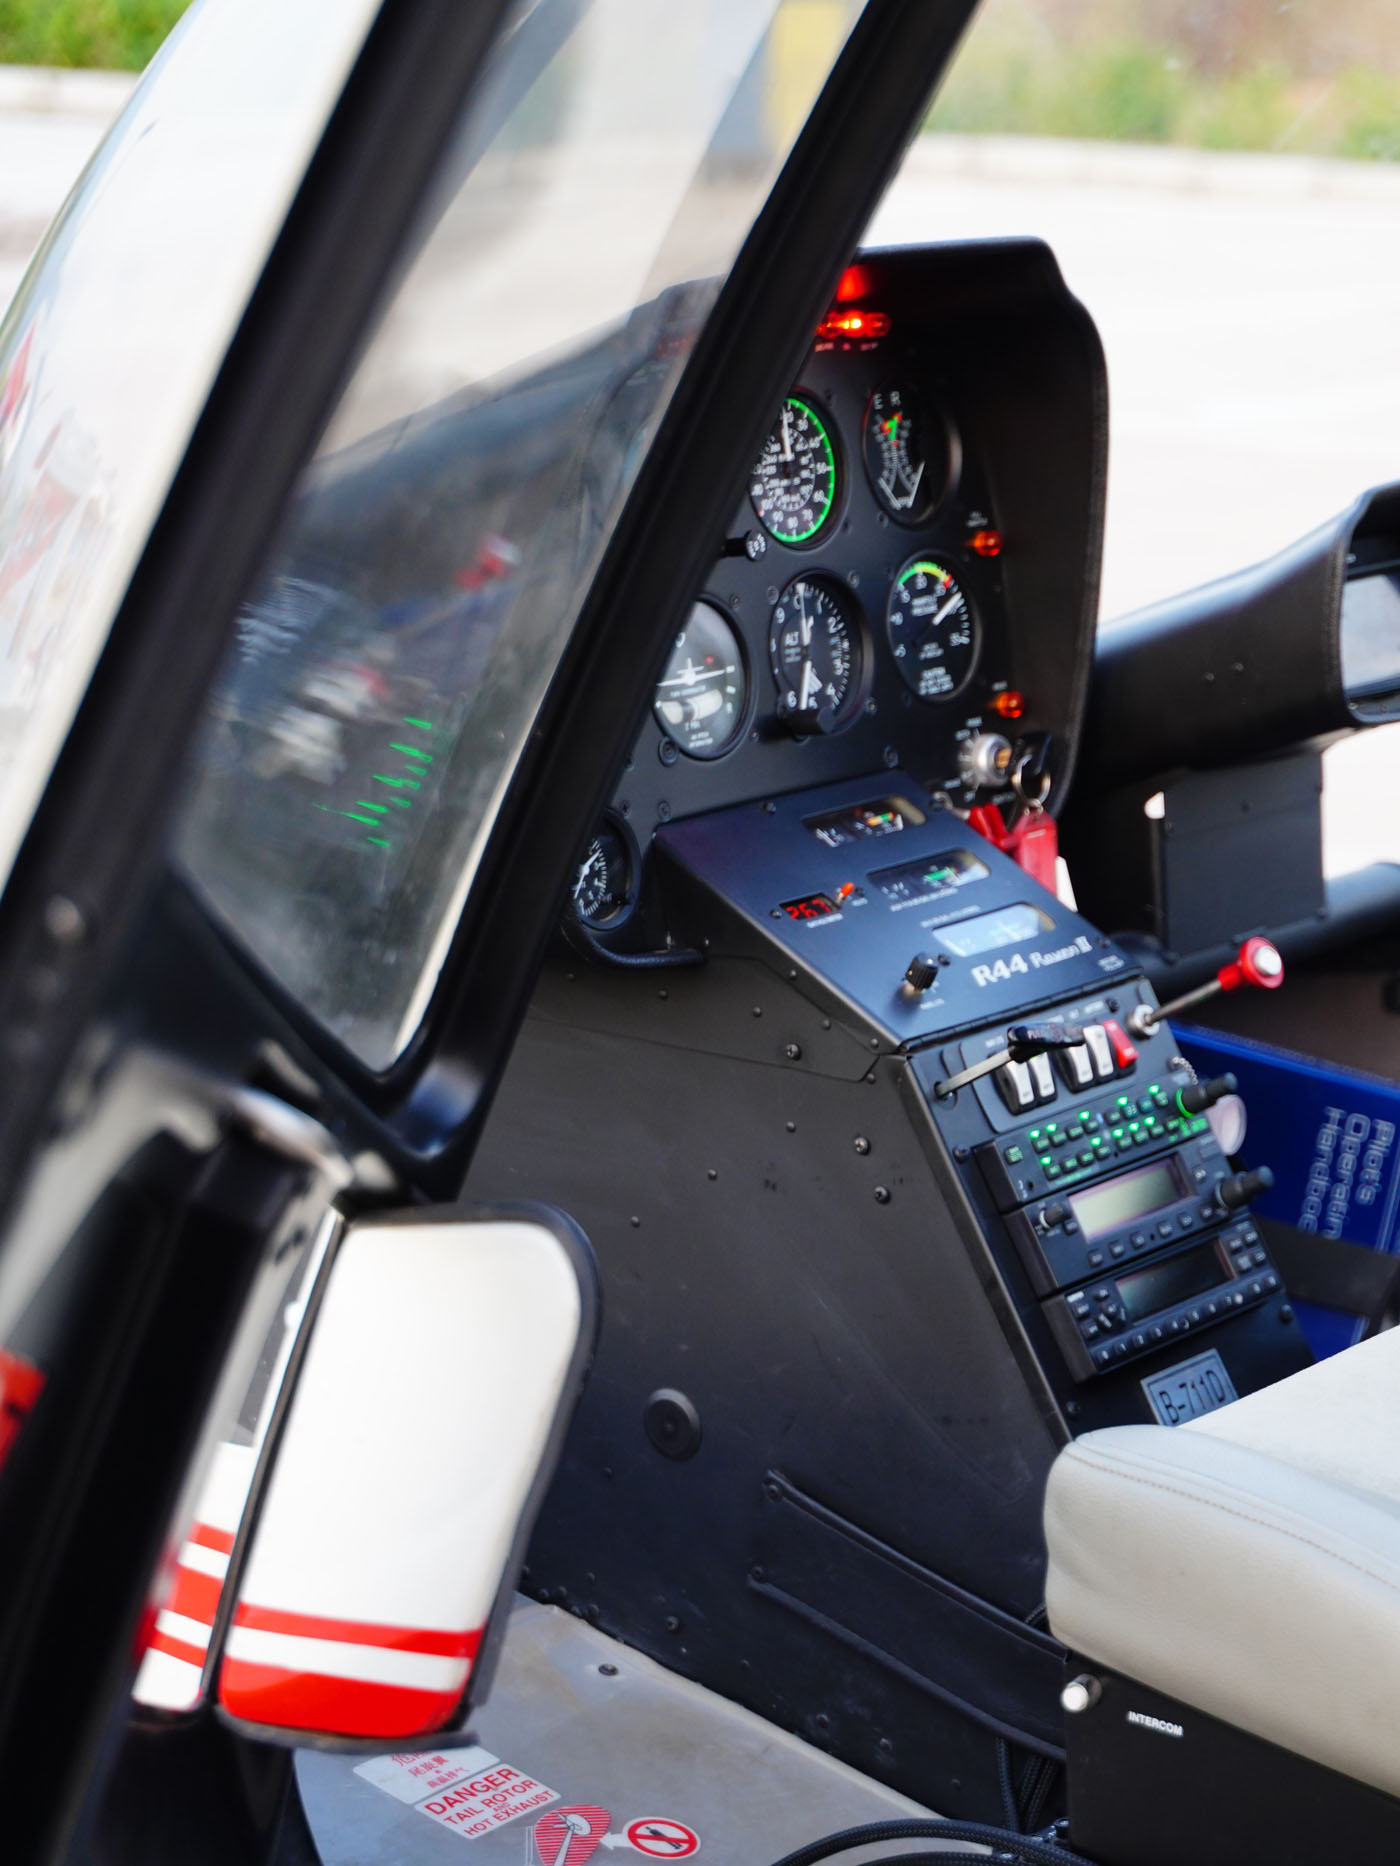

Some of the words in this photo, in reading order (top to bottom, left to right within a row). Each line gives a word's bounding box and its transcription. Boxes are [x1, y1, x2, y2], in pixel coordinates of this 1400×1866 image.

[872, 392, 883, 410] E
[890, 390, 901, 407] R
[784, 631, 800, 647] ALT
[971, 953, 1029, 987] R44
[1028, 943, 1081, 969] Raven
[1297, 1105, 1347, 1235] Handboo
[1320, 1112, 1371, 1240] Operatin
[1355, 1117, 1396, 1206] Pilot's
[1128, 1710, 1184, 1737] INTERCOM
[424, 1768, 520, 1816] DANGER
[443, 1806, 484, 1827] TAIL
[481, 1779, 539, 1808] ROTOR
[464, 1818, 496, 1837] HOT
[493, 1790, 556, 1822] EXHAUST
[493, 1801, 512, 1814] AND
